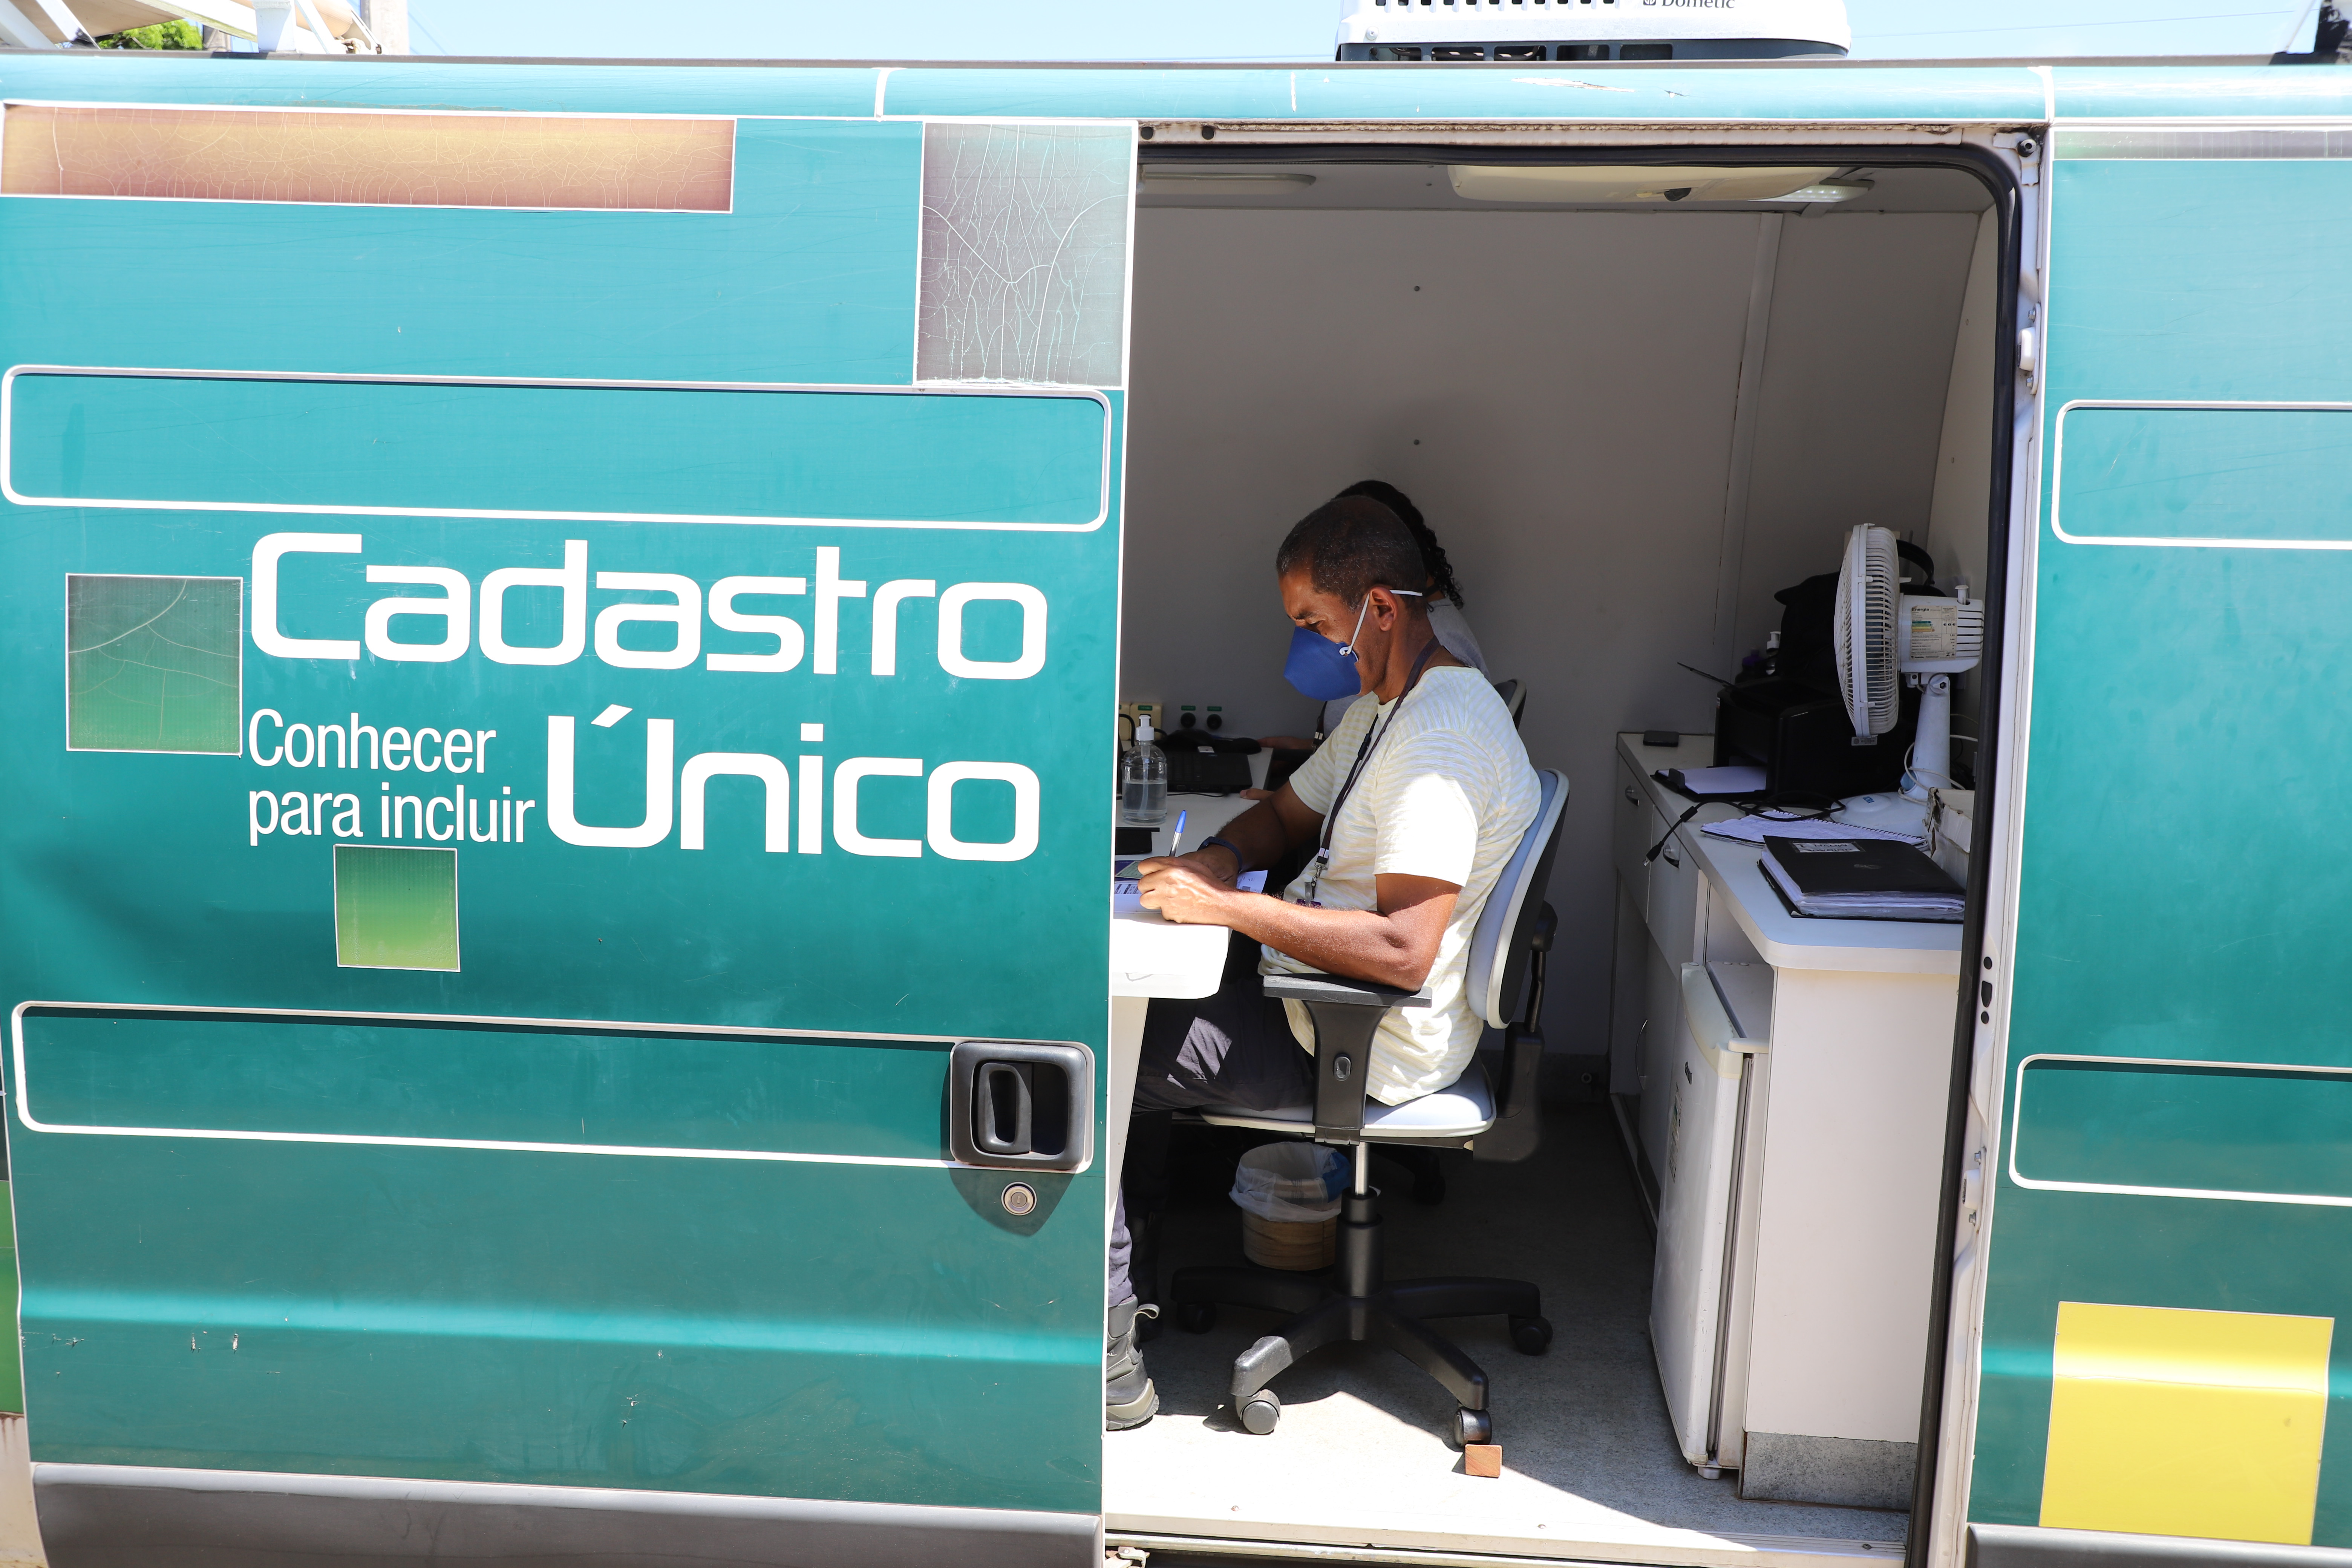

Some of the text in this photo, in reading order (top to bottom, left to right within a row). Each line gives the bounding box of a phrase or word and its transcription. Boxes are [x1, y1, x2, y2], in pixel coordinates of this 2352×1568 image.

[251, 532, 1047, 680] Cadastro
[249, 708, 496, 773] Conhecer
[547, 704, 1040, 862] Único
[249, 782, 535, 847] para incluir
